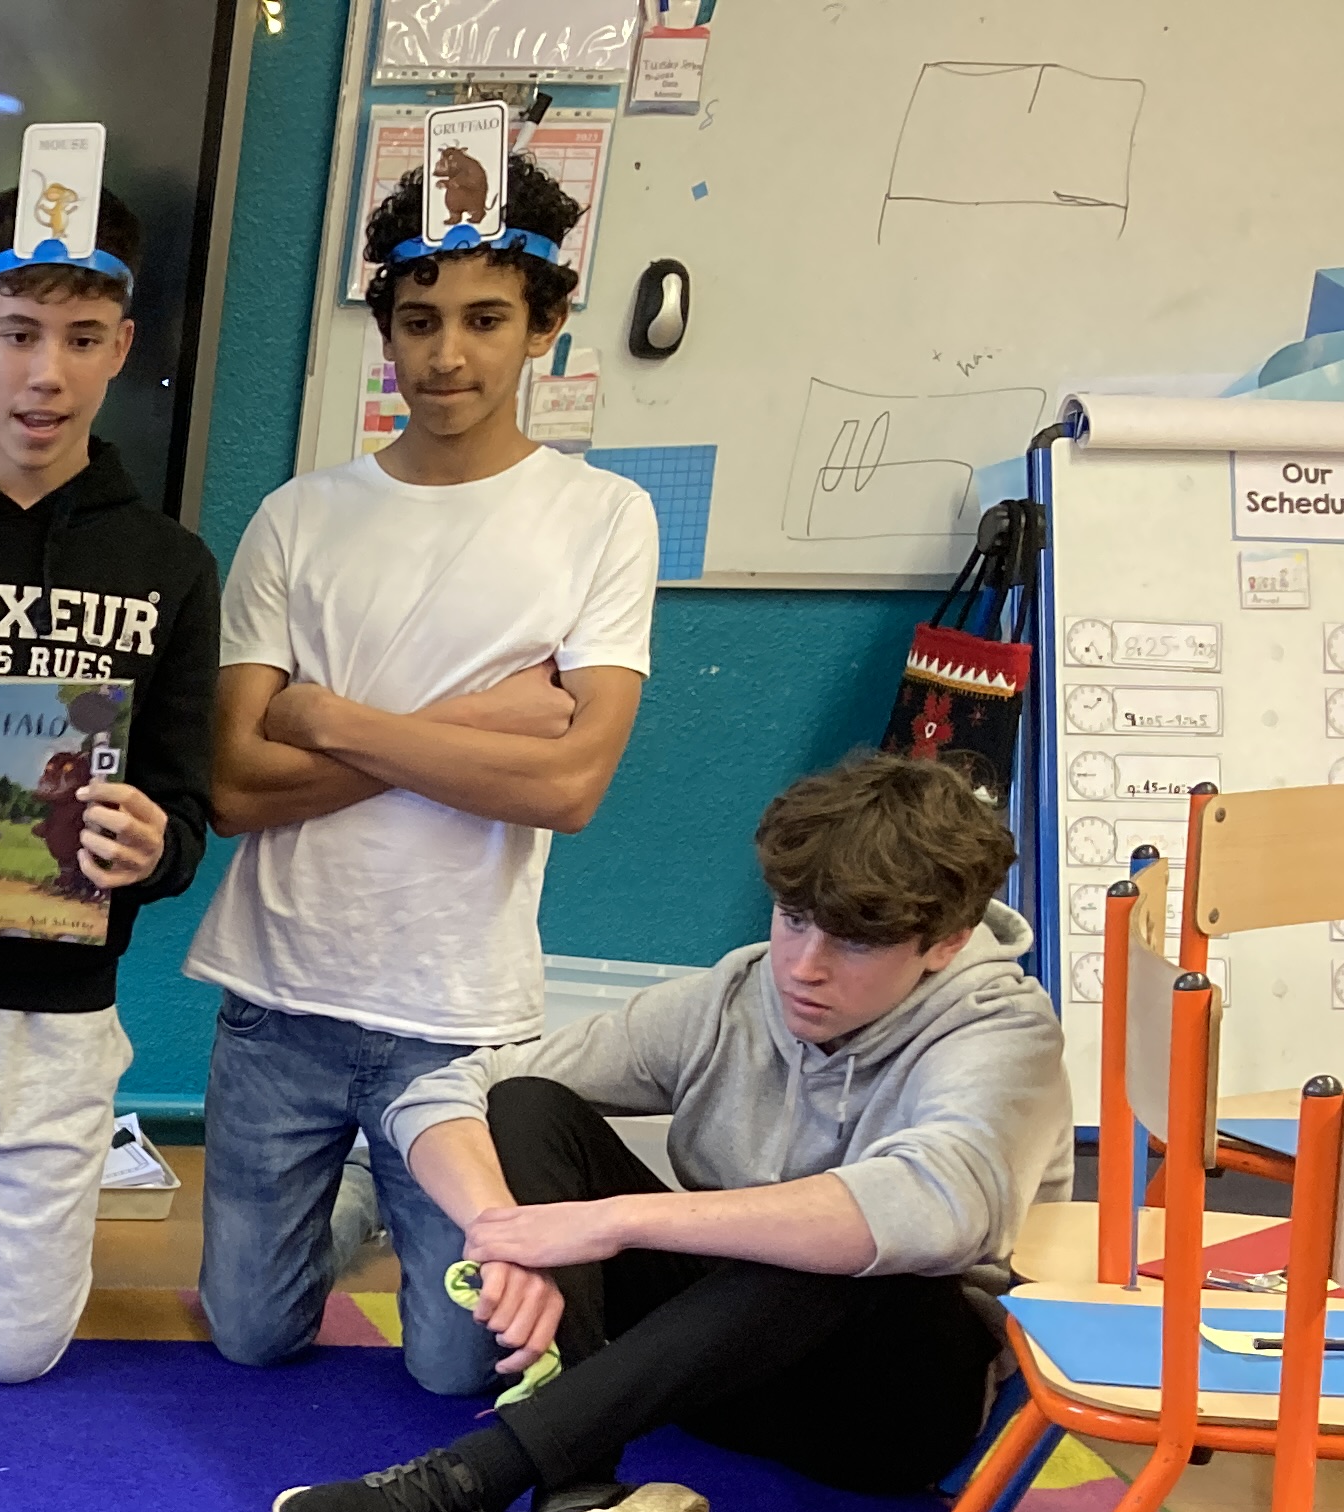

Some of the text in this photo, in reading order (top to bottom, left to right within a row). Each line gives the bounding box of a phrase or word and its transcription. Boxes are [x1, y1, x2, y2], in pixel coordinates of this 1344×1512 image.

[433, 117, 500, 137] GRUFFALO
[1282, 462, 1333, 484] Our
[1246, 490, 1344, 515] Schedu
[27, 646, 113, 681] RUES
[98, 753, 114, 770] D
